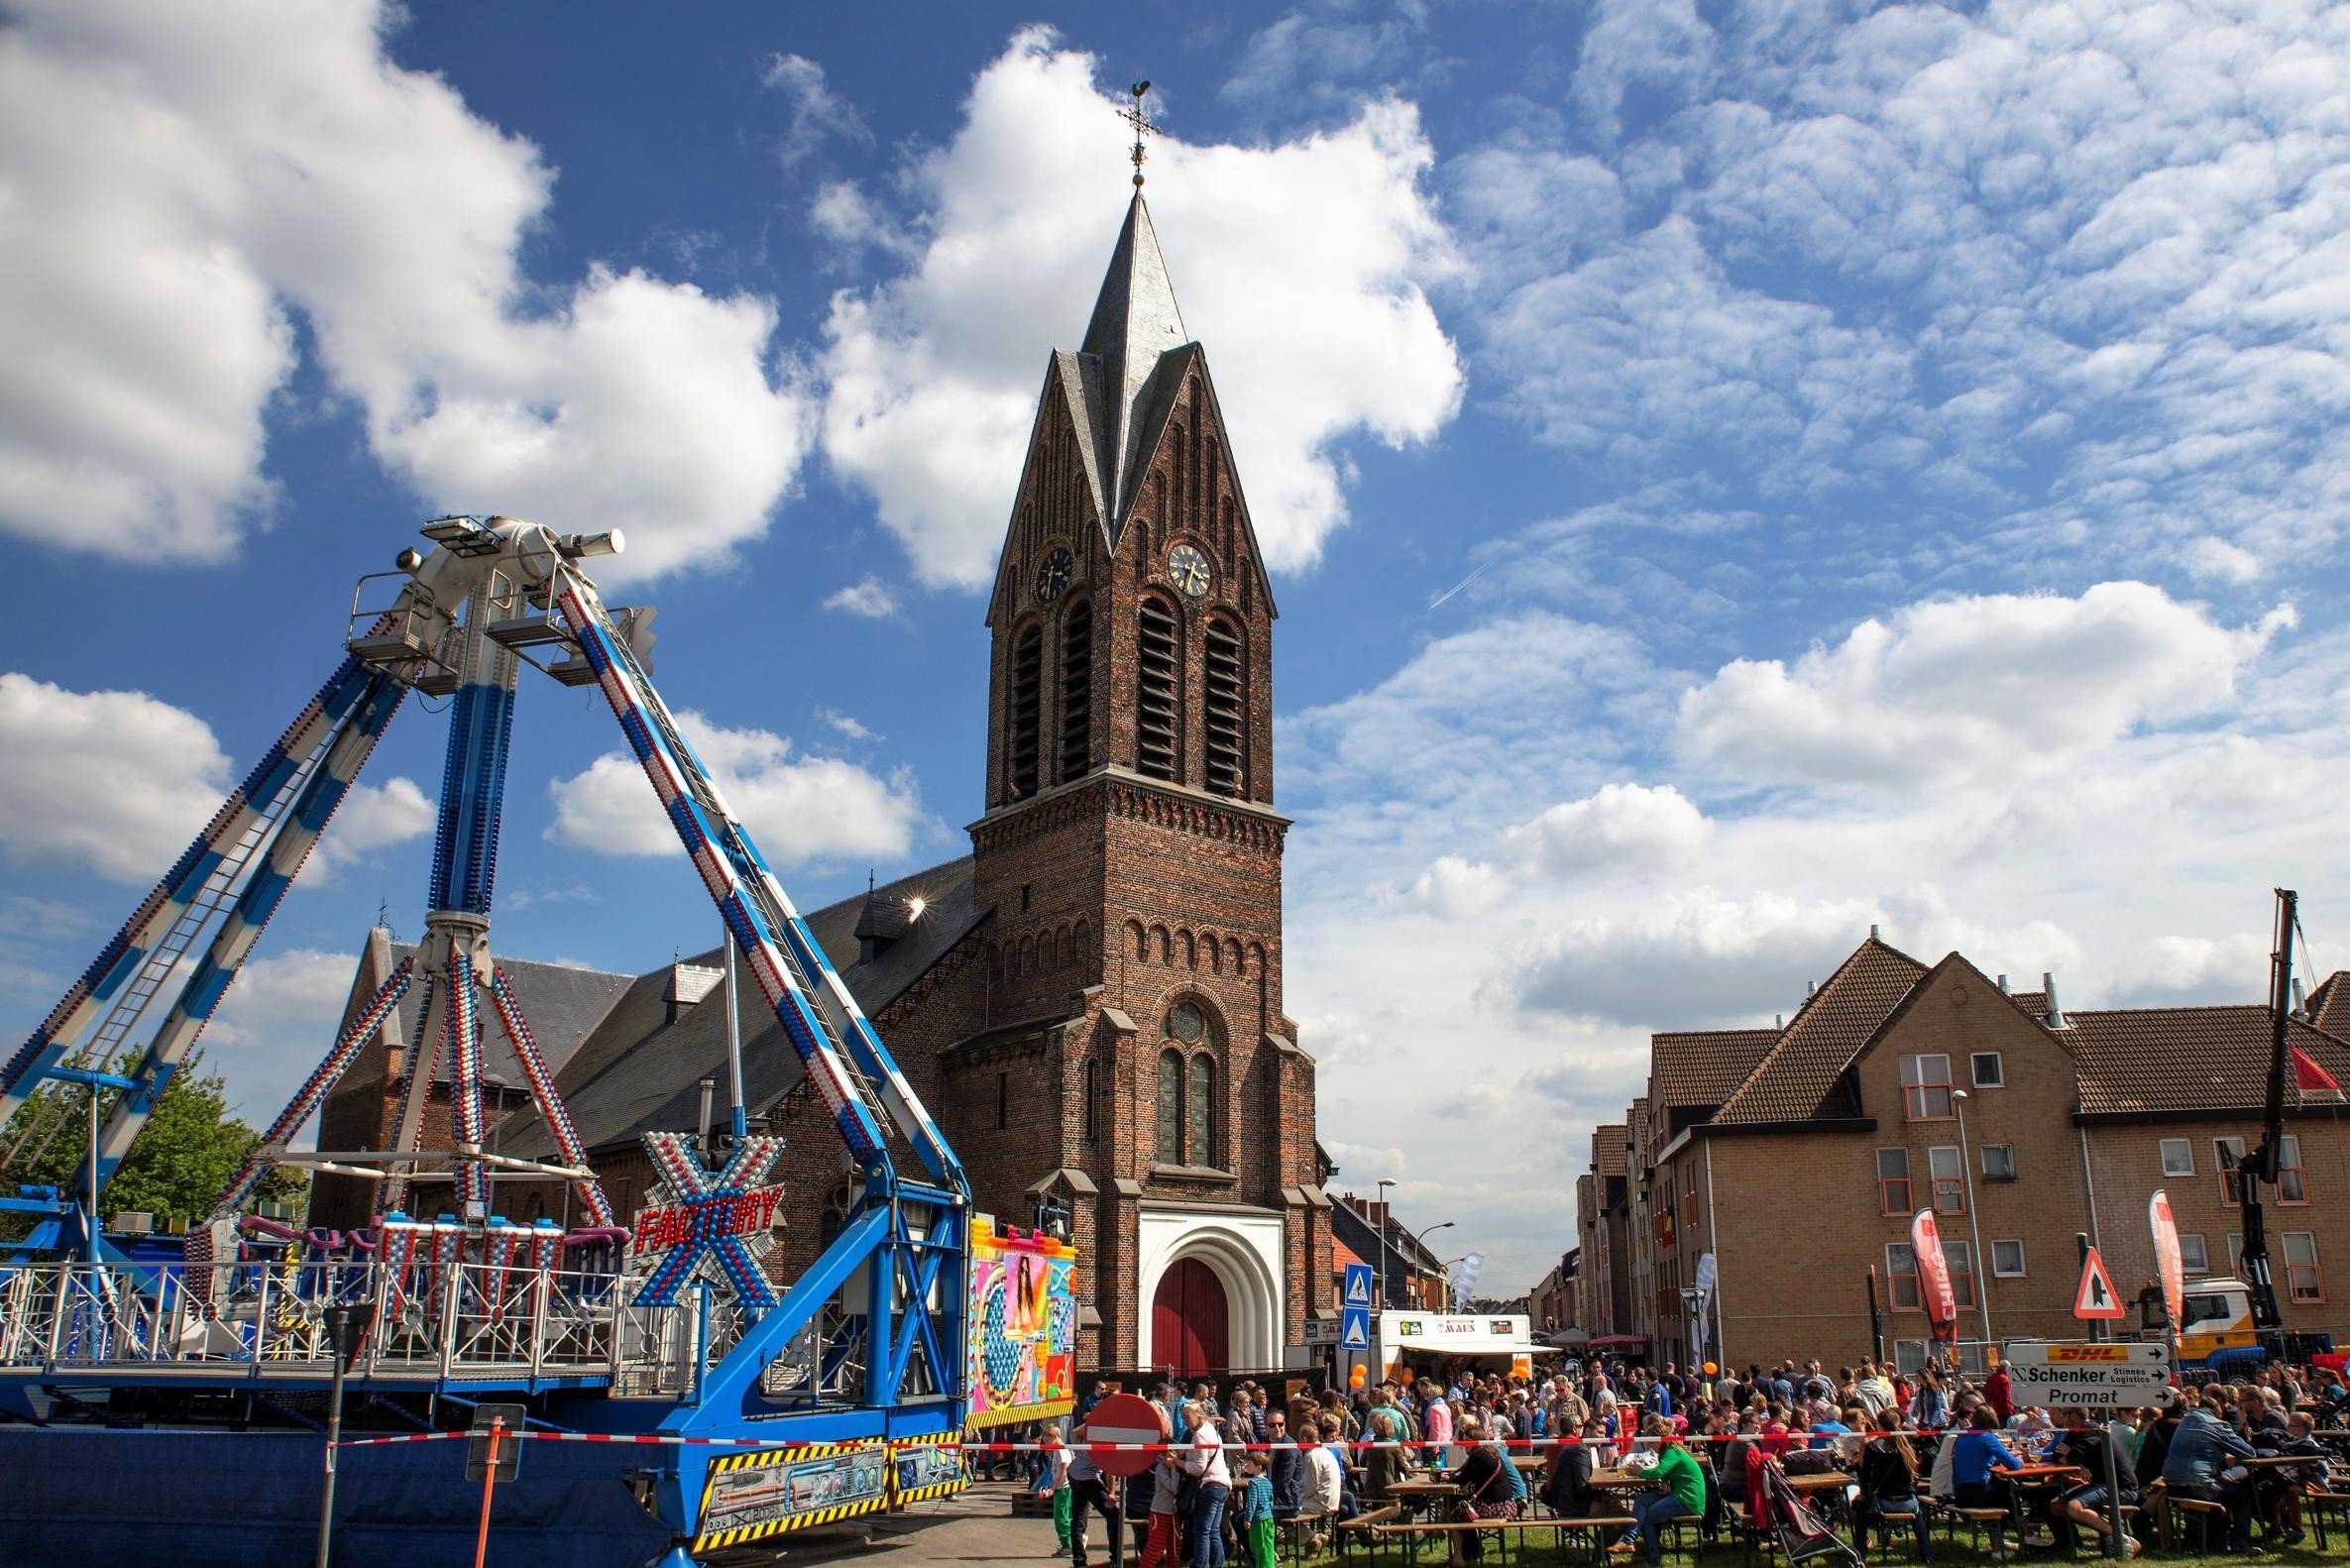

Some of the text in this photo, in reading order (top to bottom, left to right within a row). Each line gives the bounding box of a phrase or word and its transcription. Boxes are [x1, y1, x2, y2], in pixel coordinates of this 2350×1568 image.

[633, 1184, 784, 1255] FACTORY
[1445, 1323, 1476, 1333] MAES
[2059, 1348, 2117, 1361] DHL
[2028, 1367, 2106, 1383] Schenker
[2113, 1367, 2146, 1376] Stinnes
[2110, 1375, 2150, 1384] Logistics
[2049, 1389, 2118, 1403] Promat
